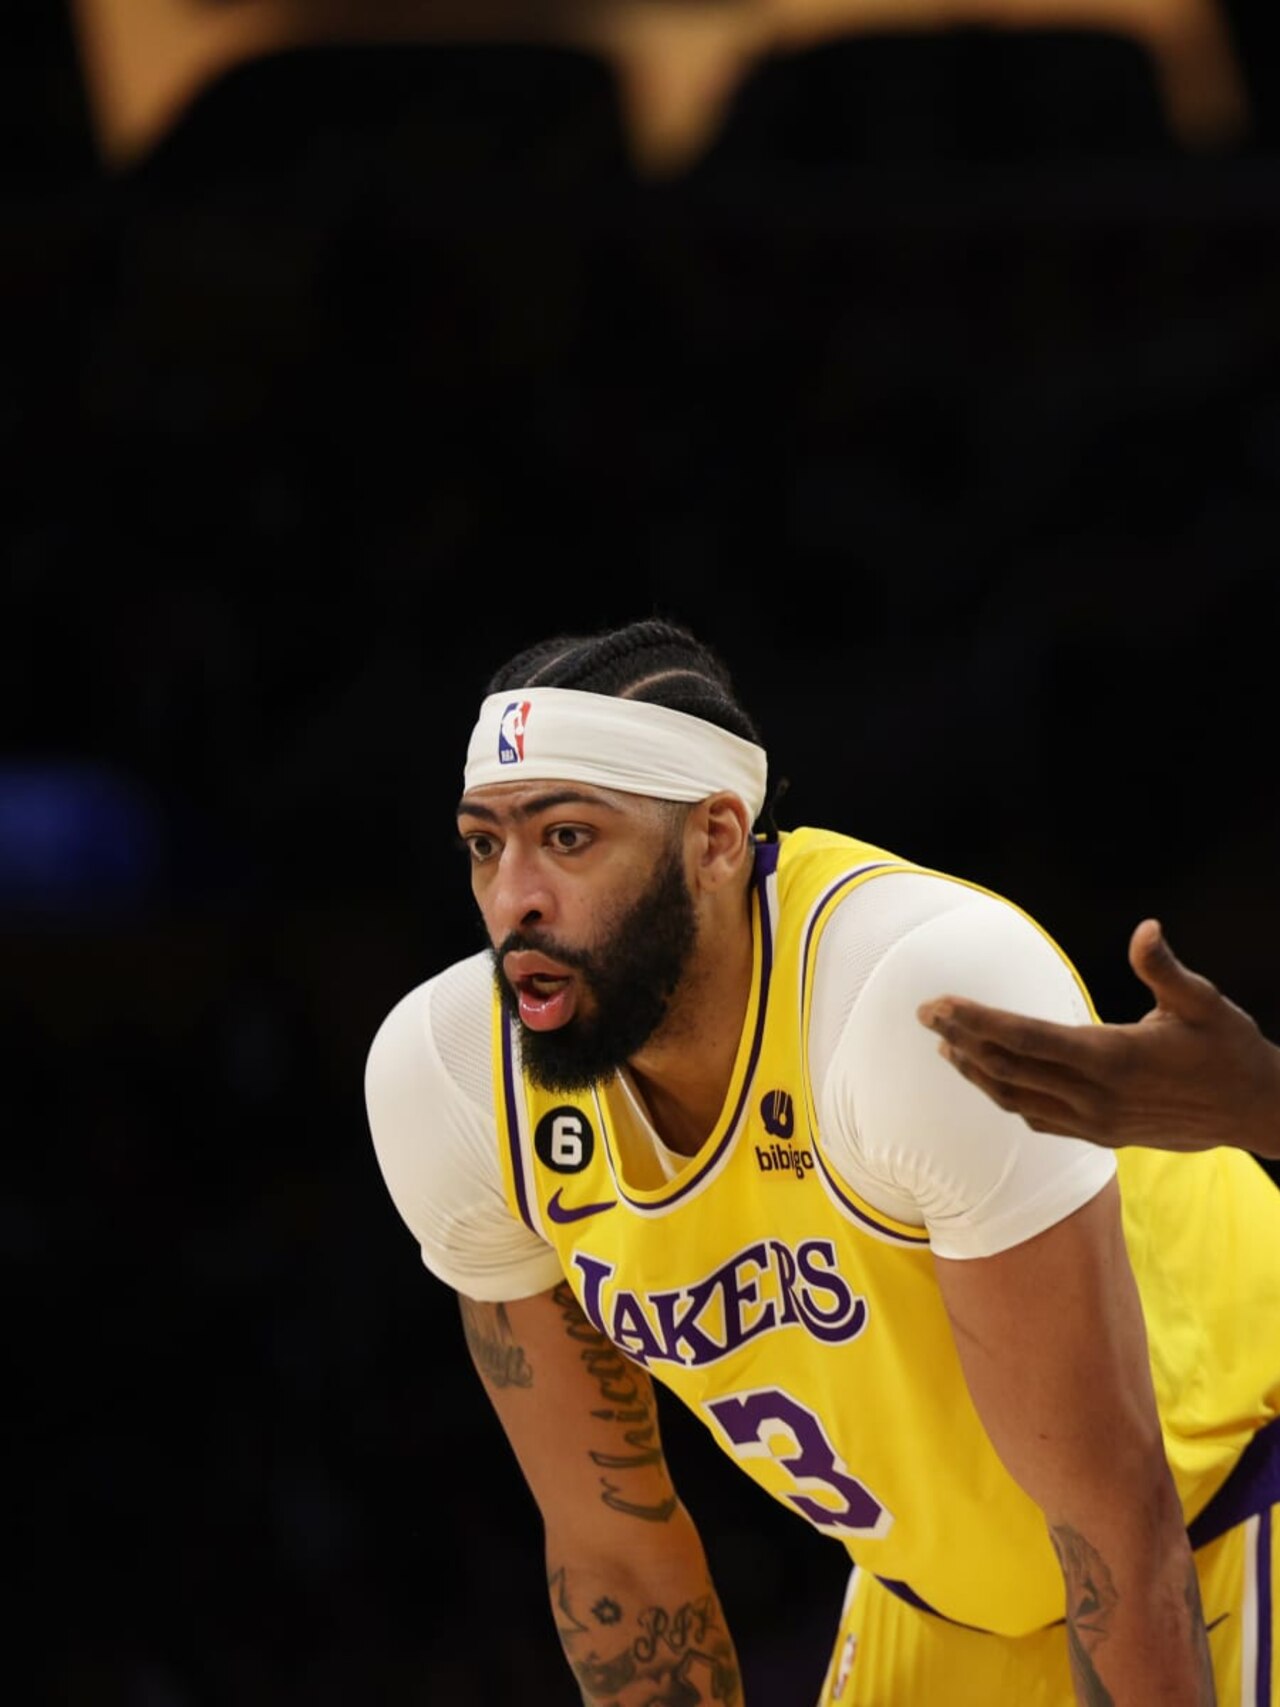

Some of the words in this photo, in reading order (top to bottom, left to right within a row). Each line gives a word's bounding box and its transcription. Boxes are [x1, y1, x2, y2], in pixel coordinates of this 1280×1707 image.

[551, 1116, 583, 1167] 6
[754, 1142, 815, 1180] bibigo
[572, 1238, 868, 1367] LAKERS
[704, 1387, 889, 1535] 3
